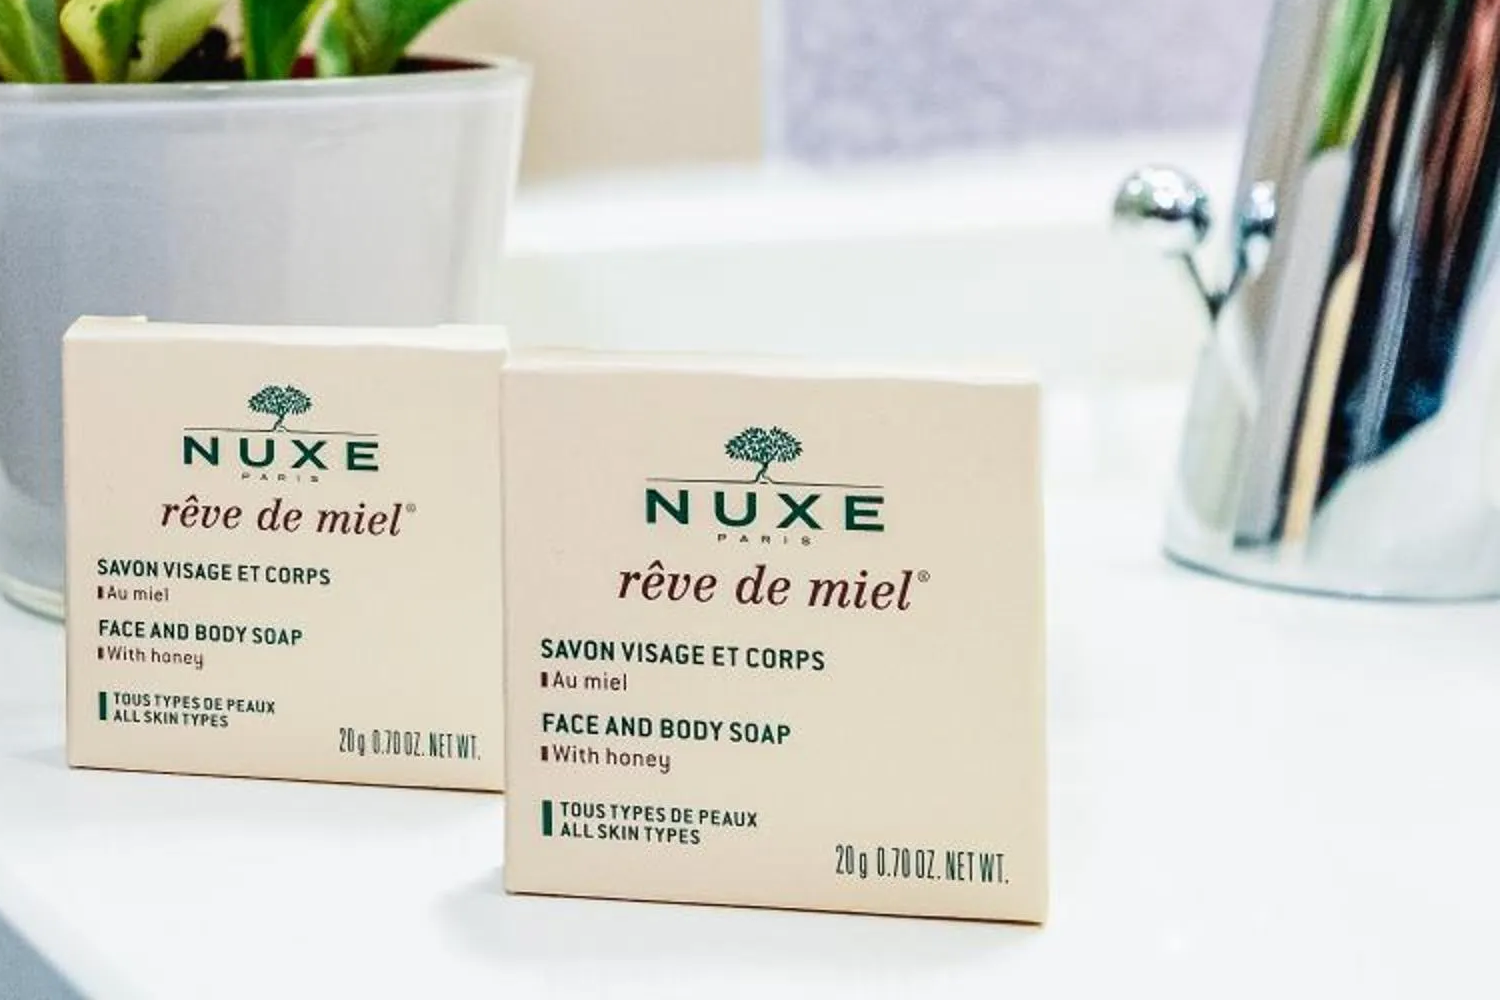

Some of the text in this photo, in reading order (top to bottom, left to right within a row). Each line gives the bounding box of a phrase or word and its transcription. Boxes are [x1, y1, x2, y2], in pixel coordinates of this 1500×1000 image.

[183, 436, 379, 471] NUXE
[241, 473, 319, 483] PARIS
[161, 495, 242, 529] rêve
[258, 499, 303, 532] de
[645, 489, 885, 532] NUXE
[718, 533, 811, 546] PARIS
[97, 559, 331, 585] SAVON VISAGE ET CORPS
[618, 560, 717, 602] rêve
[736, 564, 791, 606] de
[107, 586, 170, 602] Au miel
[99, 620, 303, 646] FACE AND BODY SOAP
[107, 647, 203, 669] With honey
[540, 639, 825, 670] SAVON VISAGE ET CORPS
[552, 671, 628, 691] Au miel
[113, 693, 275, 714] TOUS TYPES DE PEAUX
[113, 710, 229, 728] ALL SKIN TYPES
[542, 713, 791, 745] FACE AND BODY SOAP
[429, 733, 452, 758] NET
[457, 736, 481, 761] WT.
[552, 746, 671, 774] With honey
[560, 802, 758, 828] TOUS TYPES DE PEAUX
[560, 823, 701, 845] ALL SKIN TYPES
[945, 851, 974, 882] NET
[979, 853, 1009, 885] WT.
